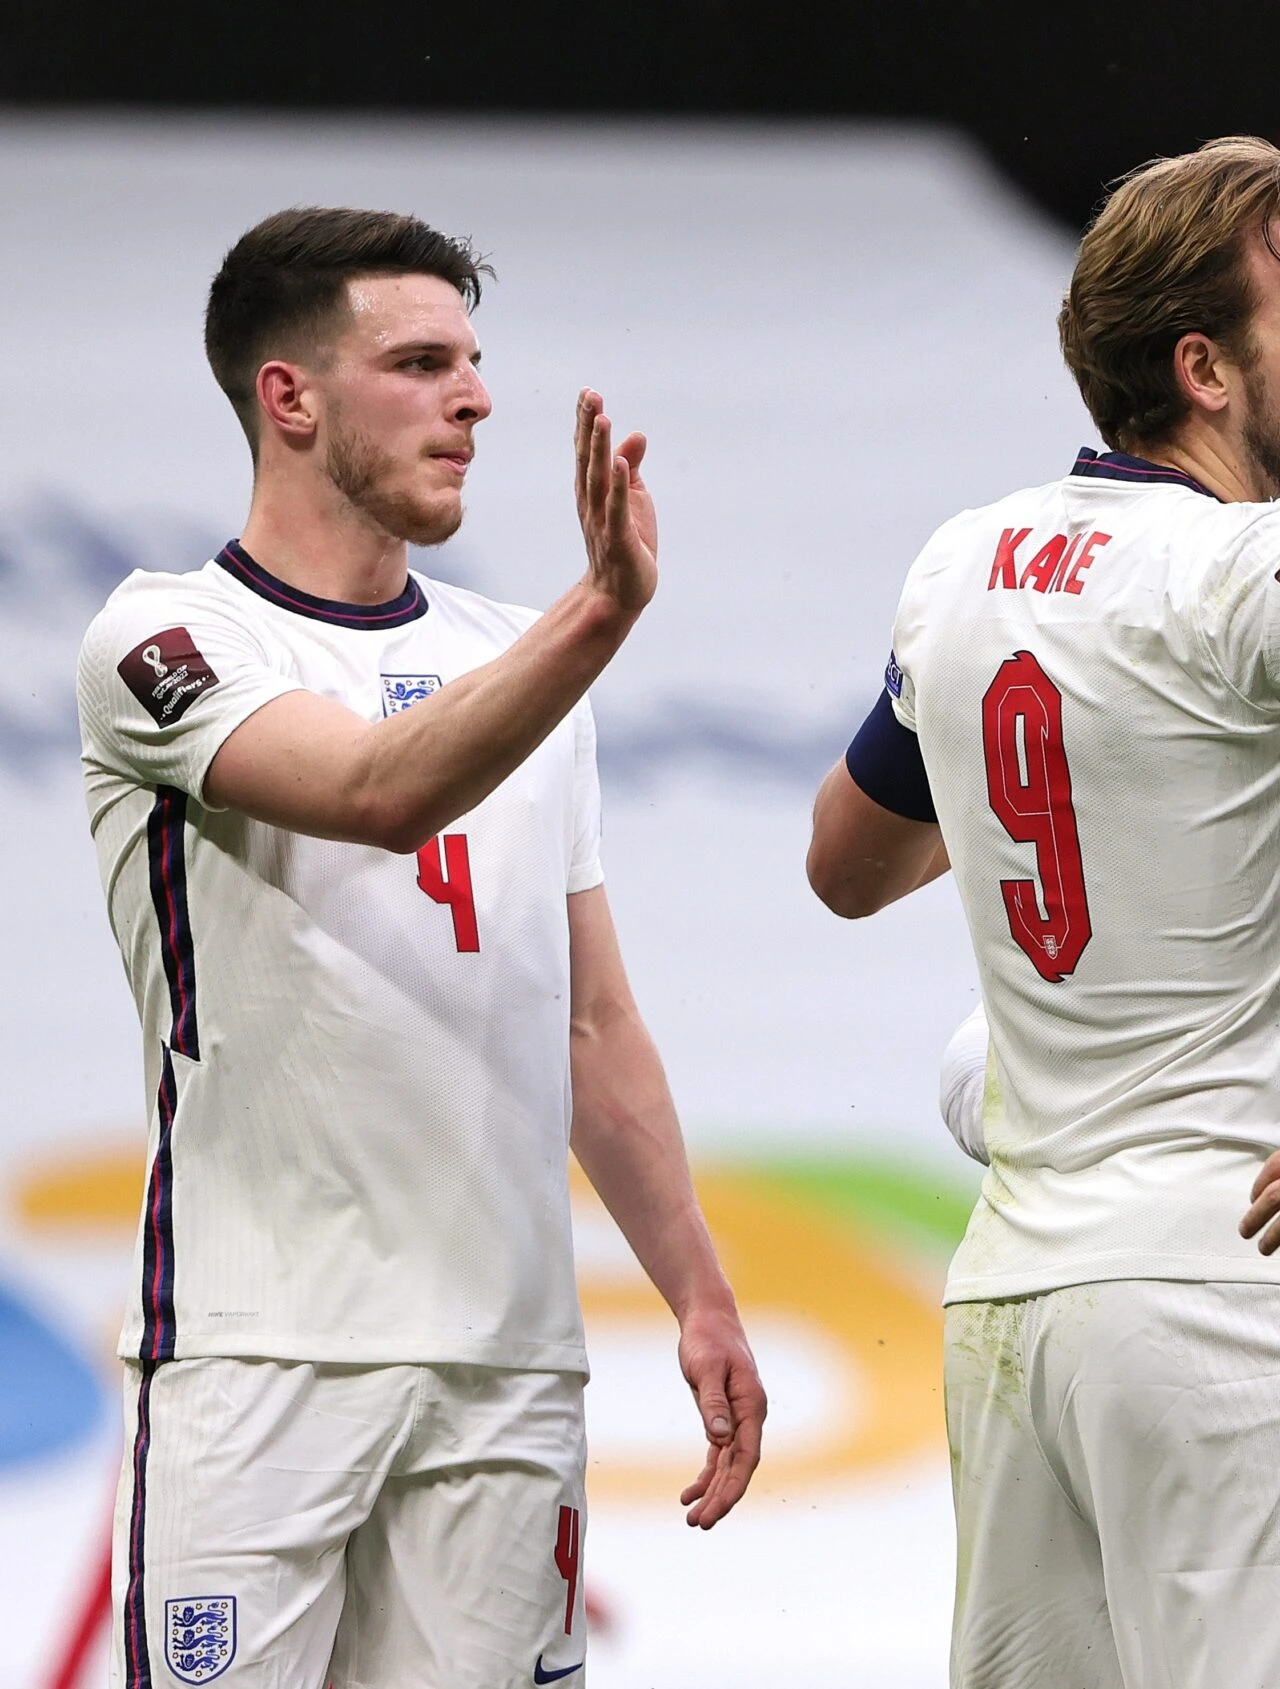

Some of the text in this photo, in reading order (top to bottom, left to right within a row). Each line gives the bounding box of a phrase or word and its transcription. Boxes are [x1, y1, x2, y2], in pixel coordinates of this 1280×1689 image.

[982, 650, 1092, 983] 9
[416, 833, 480, 952] 4
[554, 1504, 579, 1635] 4
